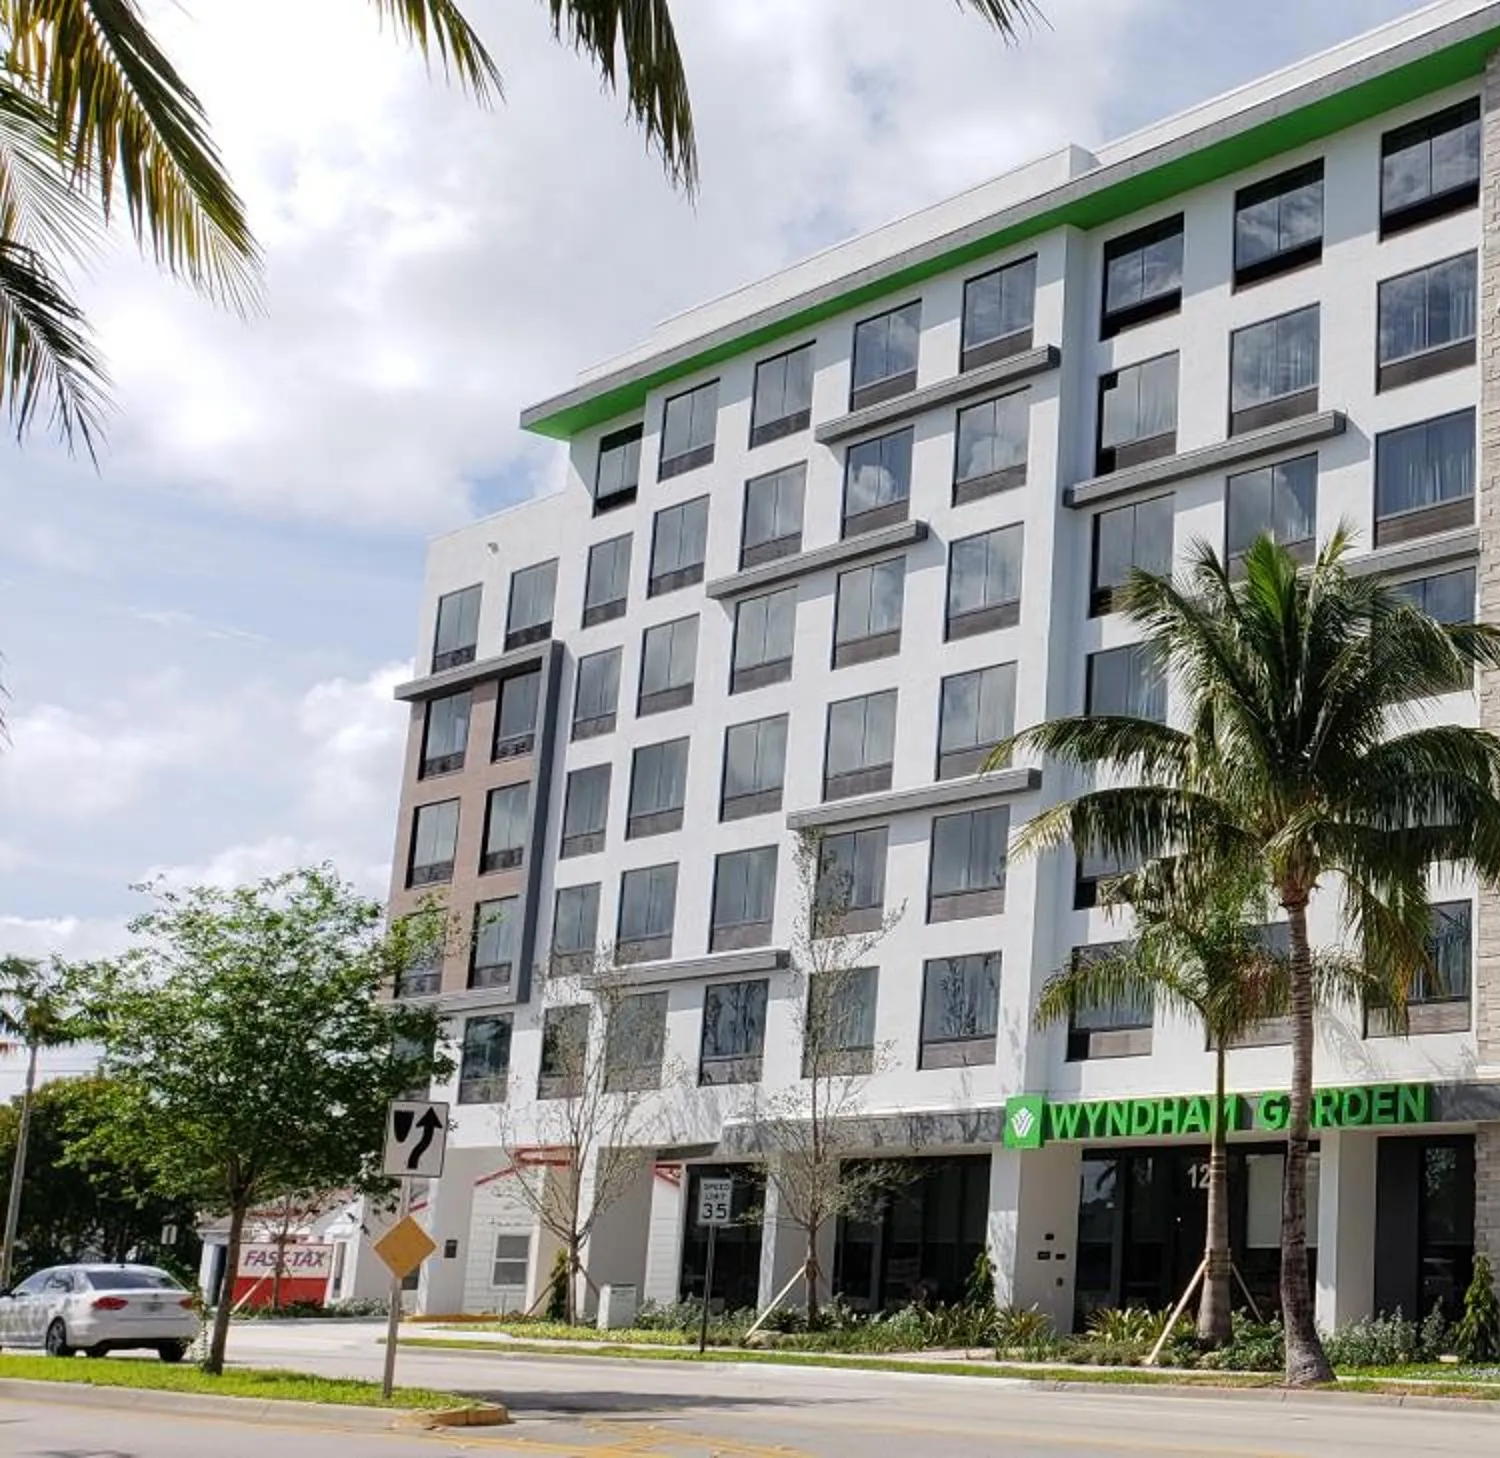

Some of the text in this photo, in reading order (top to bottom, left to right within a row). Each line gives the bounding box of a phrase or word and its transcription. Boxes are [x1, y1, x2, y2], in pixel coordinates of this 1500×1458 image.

[1049, 1082, 1426, 1140] WYNDHAM GRDEN
[703, 1203, 727, 1219] 35
[244, 1248, 325, 1267] FAS-TAX
